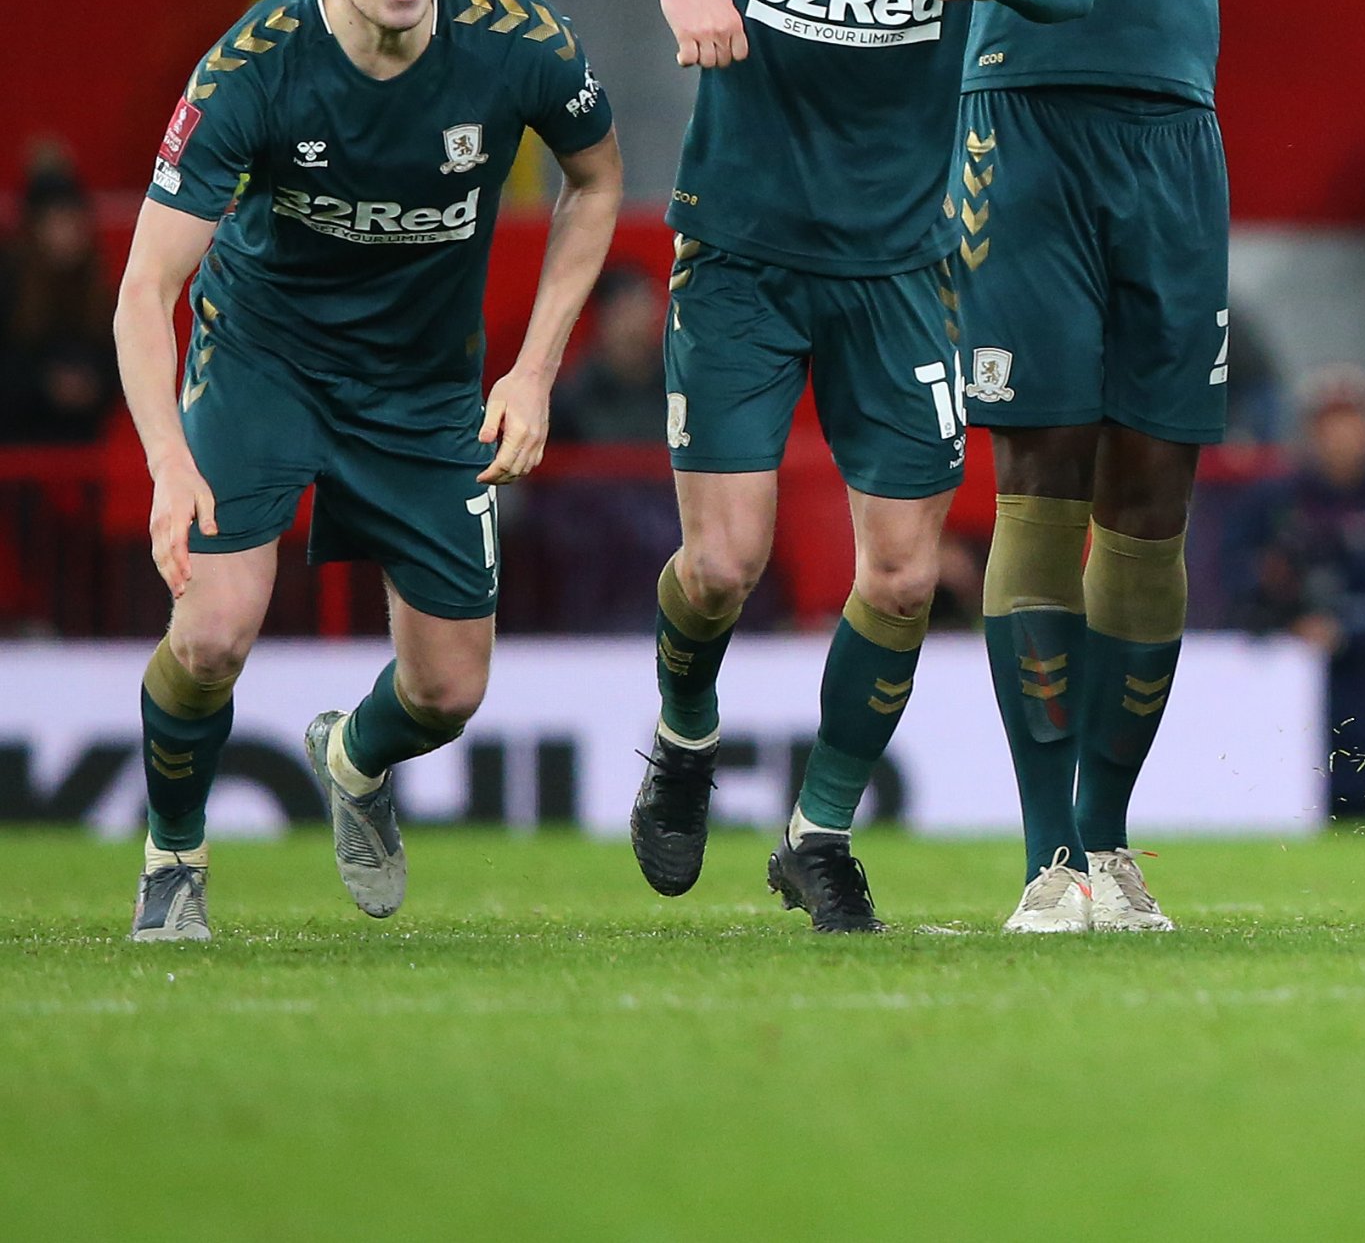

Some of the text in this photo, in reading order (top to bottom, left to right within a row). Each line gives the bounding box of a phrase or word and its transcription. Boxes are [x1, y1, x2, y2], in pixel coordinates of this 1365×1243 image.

[783, 17, 904, 44] SET YOUR LIMITS
[275, 186, 480, 232] 32Red
[672, 189, 698, 206] CO8
[312, 223, 437, 243] SET YOUR LIMITS
